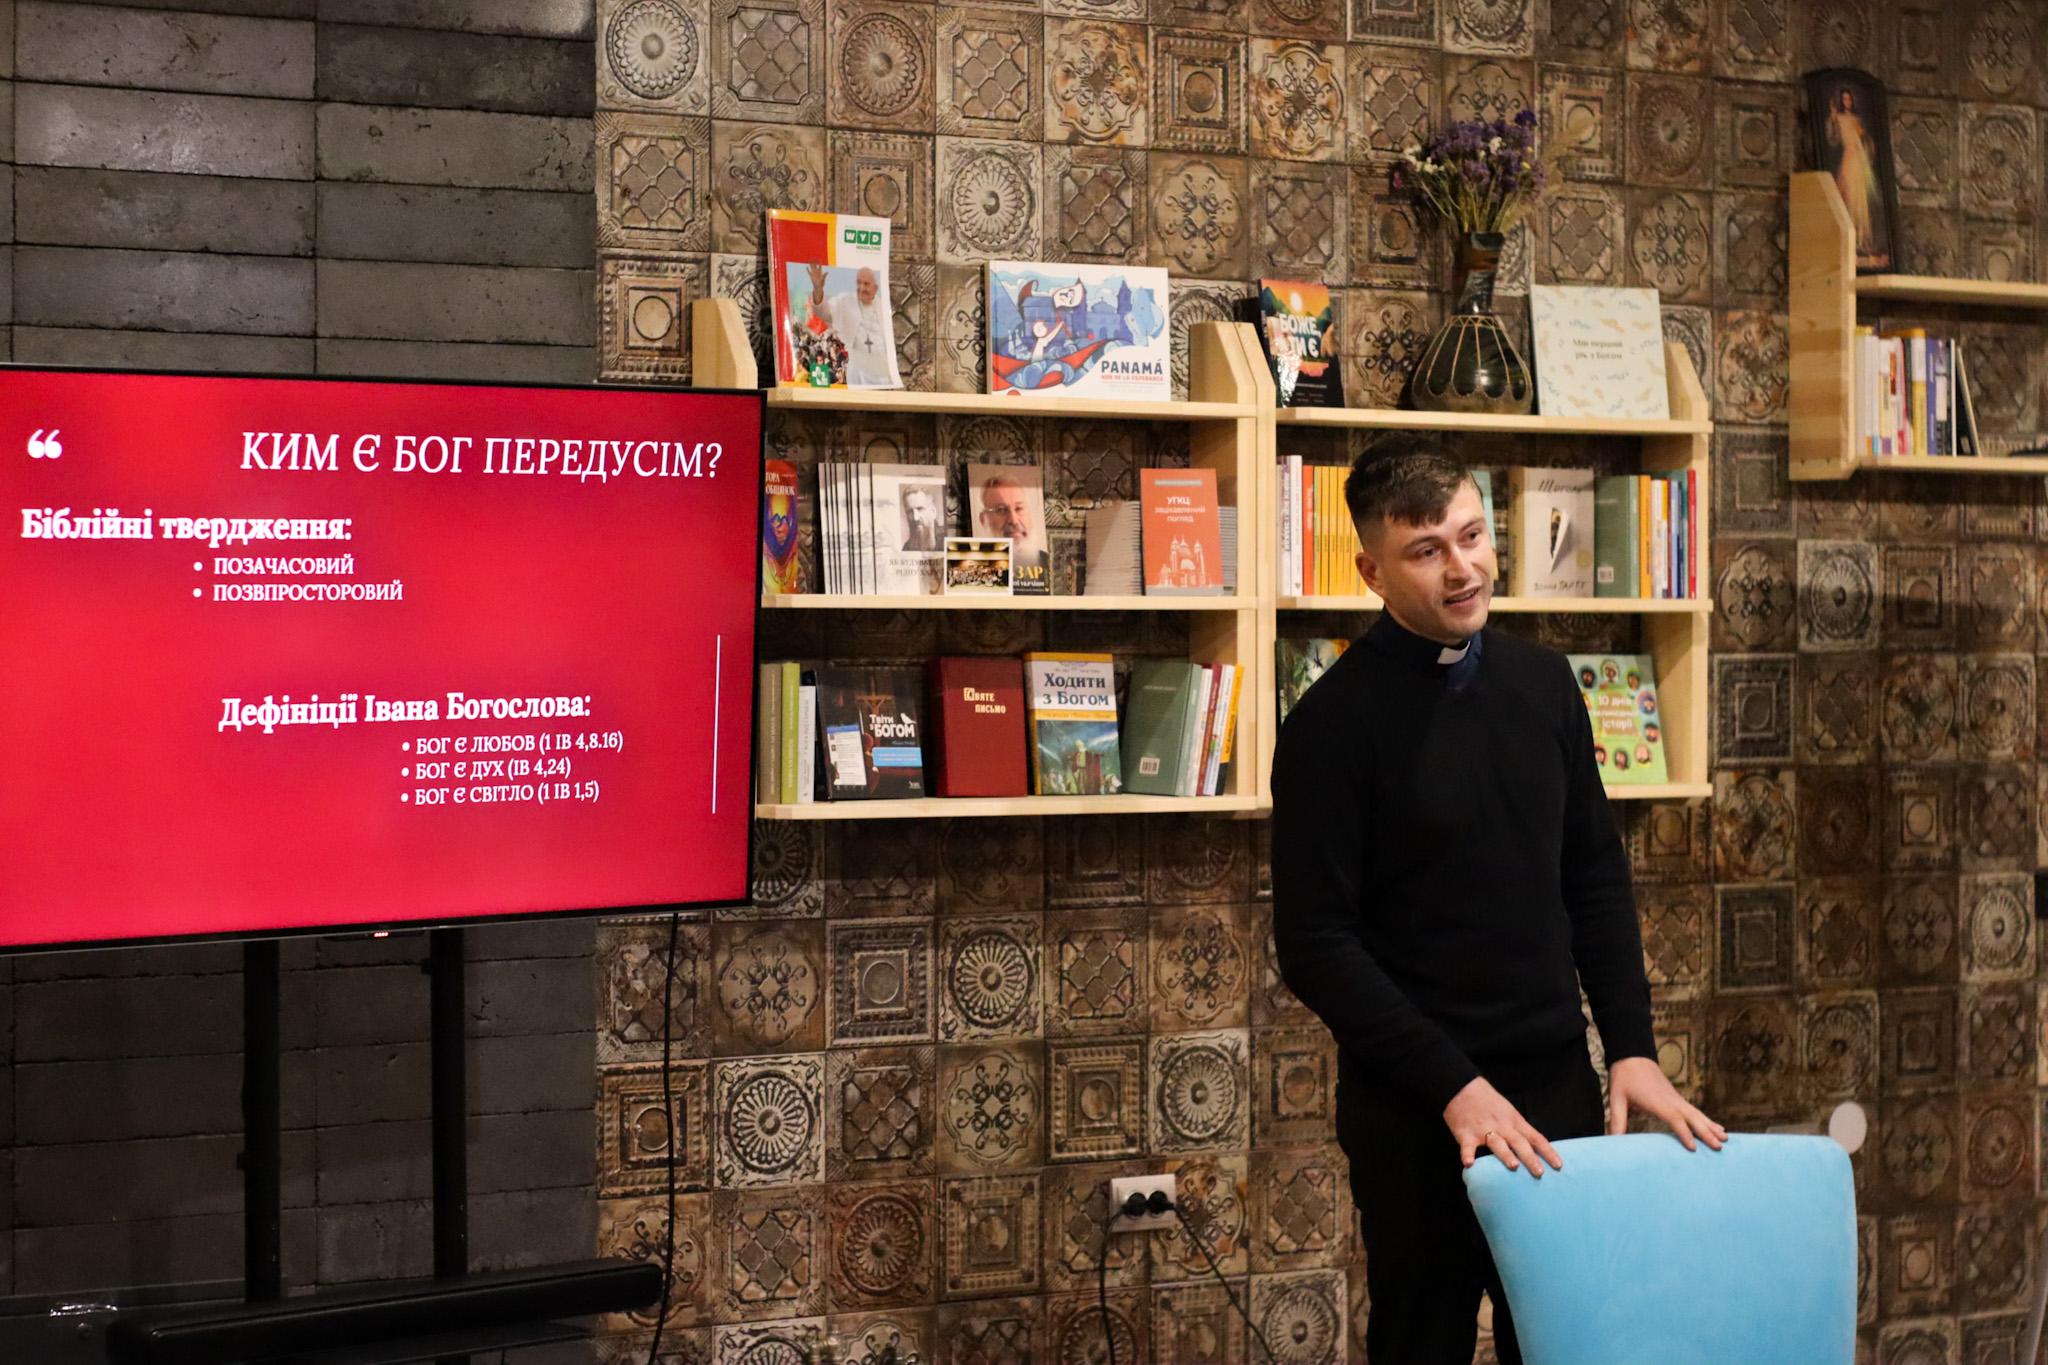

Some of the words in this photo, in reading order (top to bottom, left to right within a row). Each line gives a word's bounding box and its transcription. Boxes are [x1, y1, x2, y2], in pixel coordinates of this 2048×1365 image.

[845, 230, 881, 244] WYD
[1101, 358, 1163, 375] PANAMÁ
[239, 431, 340, 471] КИМ
[353, 433, 381, 472] Є
[393, 436, 473, 474] БОГ
[482, 438, 723, 484] ПЕРЕДУСІМ?
[1167, 496, 1191, 506] УГКЦ
[20, 507, 153, 539] Біблійні
[159, 517, 353, 549] твердження:
[213, 553, 355, 575] ПОЗАЧАСОВИЙ
[213, 579, 404, 602] ПОЗВПРОСТОРОВИЙ
[1043, 671, 1106, 690] Ходити
[1042, 693, 1052, 705] з
[1057, 690, 1110, 706] Богом
[218, 693, 359, 735] Дефініції
[364, 694, 440, 722] Івана
[446, 692, 591, 721] Богослова:
[869, 714, 894, 724] Твіти
[874, 723, 916, 738] БОГОМ
[416, 737, 450, 755] БОГ
[454, 738, 468, 753] Є
[470, 734, 536, 753] ЛЮБОВ
[539, 732, 551, 755] (1
[555, 733, 572, 751] ІВ
[575, 730, 624, 753] 4,8.16)
[415, 762, 450, 780] БОГ
[453, 762, 467, 778] Є
[470, 760, 505, 781] ДУХ
[507, 758, 530, 781] (ІВ
[533, 756, 571, 779] 4,24)
[415, 787, 449, 806] БОГ
[453, 787, 466, 804] Є
[469, 784, 534, 803] СВІТЛО
[537, 783, 549, 805] (1
[554, 783, 570, 800] ІВ
[574, 780, 600, 803] 1,5)
